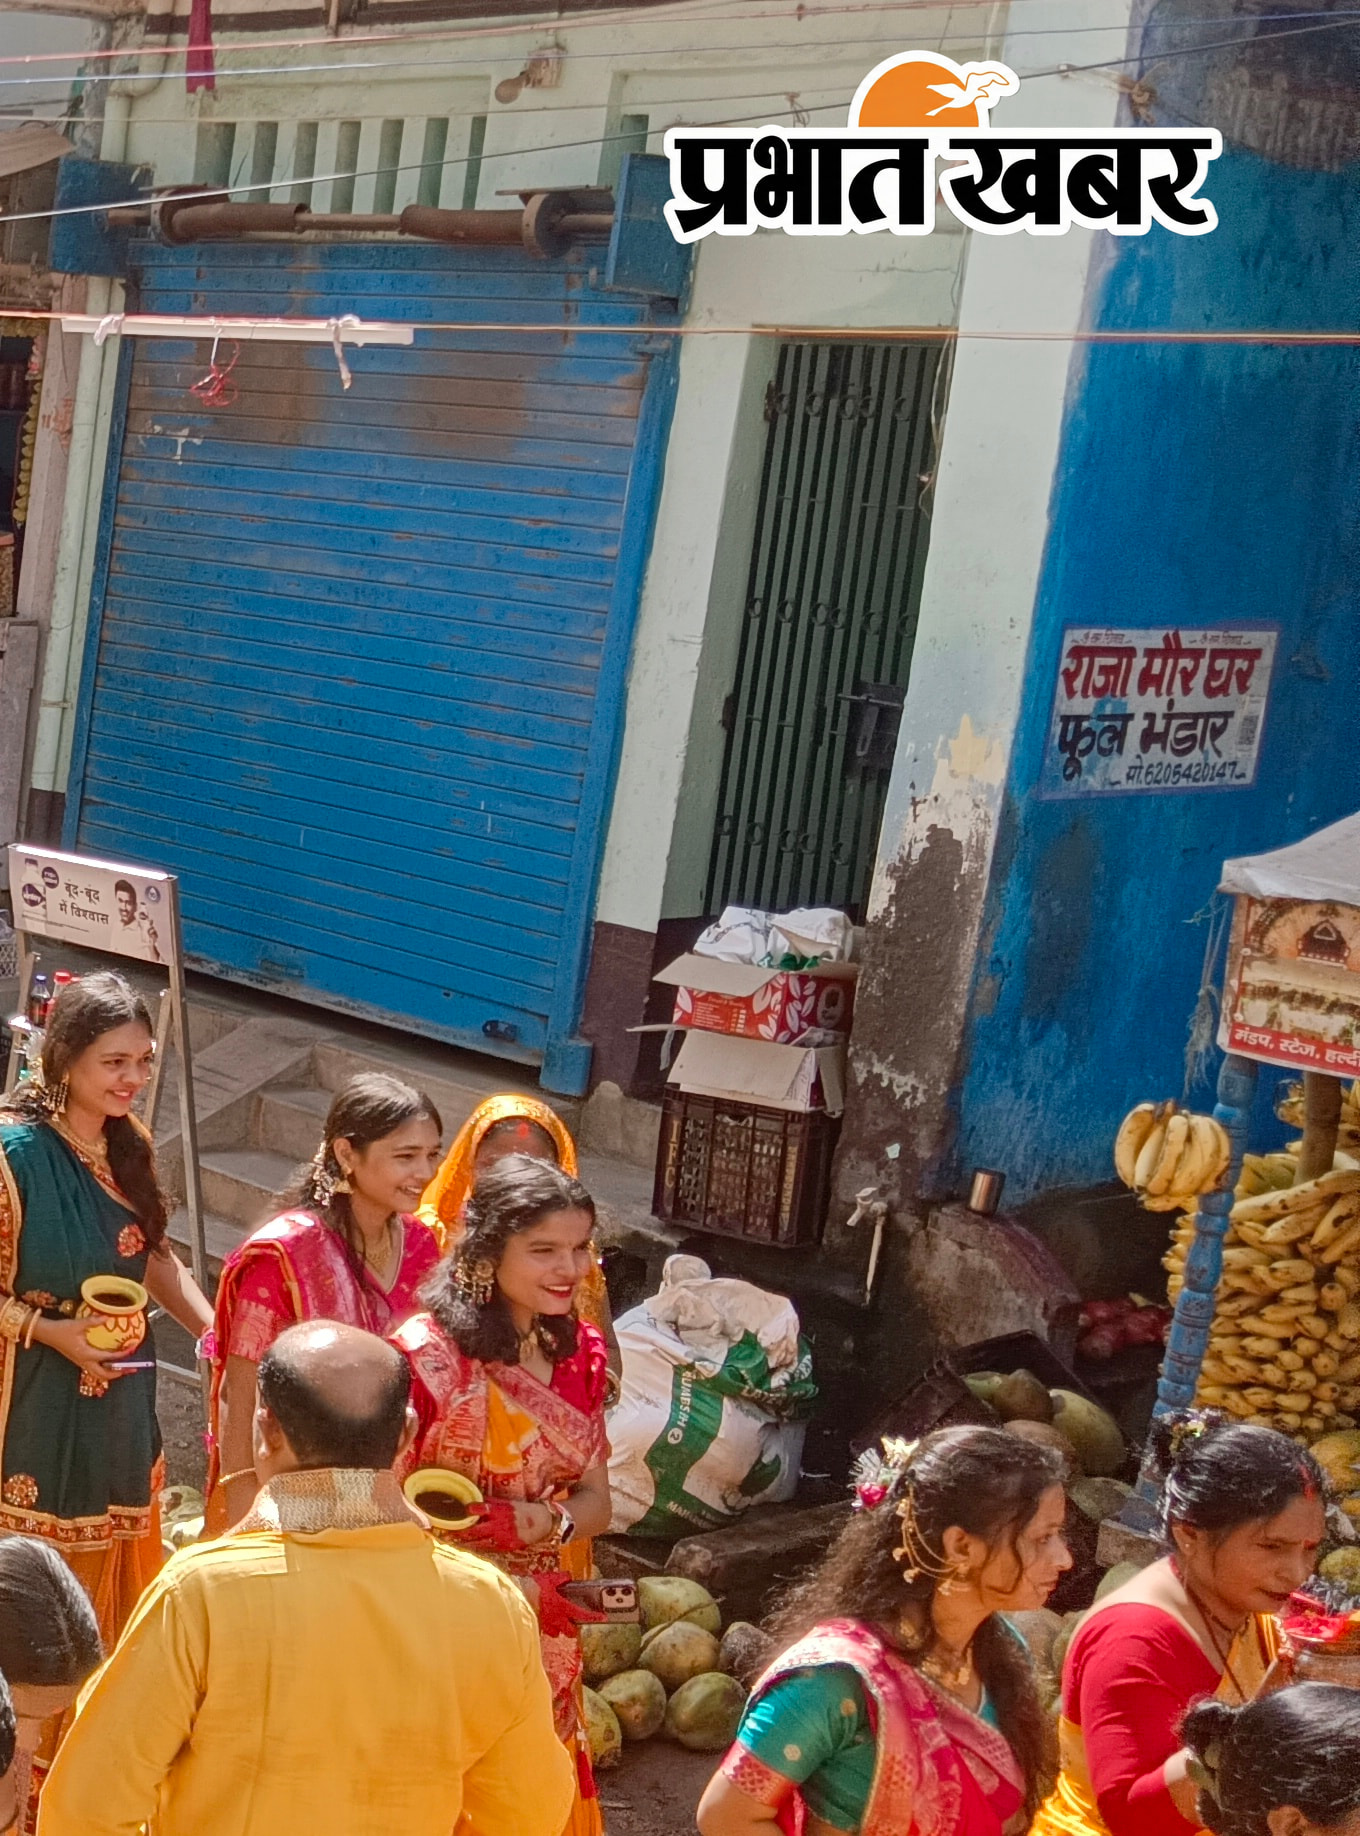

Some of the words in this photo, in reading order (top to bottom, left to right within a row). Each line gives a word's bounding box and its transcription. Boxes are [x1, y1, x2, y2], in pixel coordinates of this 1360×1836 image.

[1061, 646, 1136, 700] राजा
[1138, 629, 1206, 698] मौर
[1203, 648, 1262, 699] घर
[1058, 713, 1135, 781] फूल
[1139, 699, 1235, 757] भंडार
[70, 902, 109, 924] विश्वास
